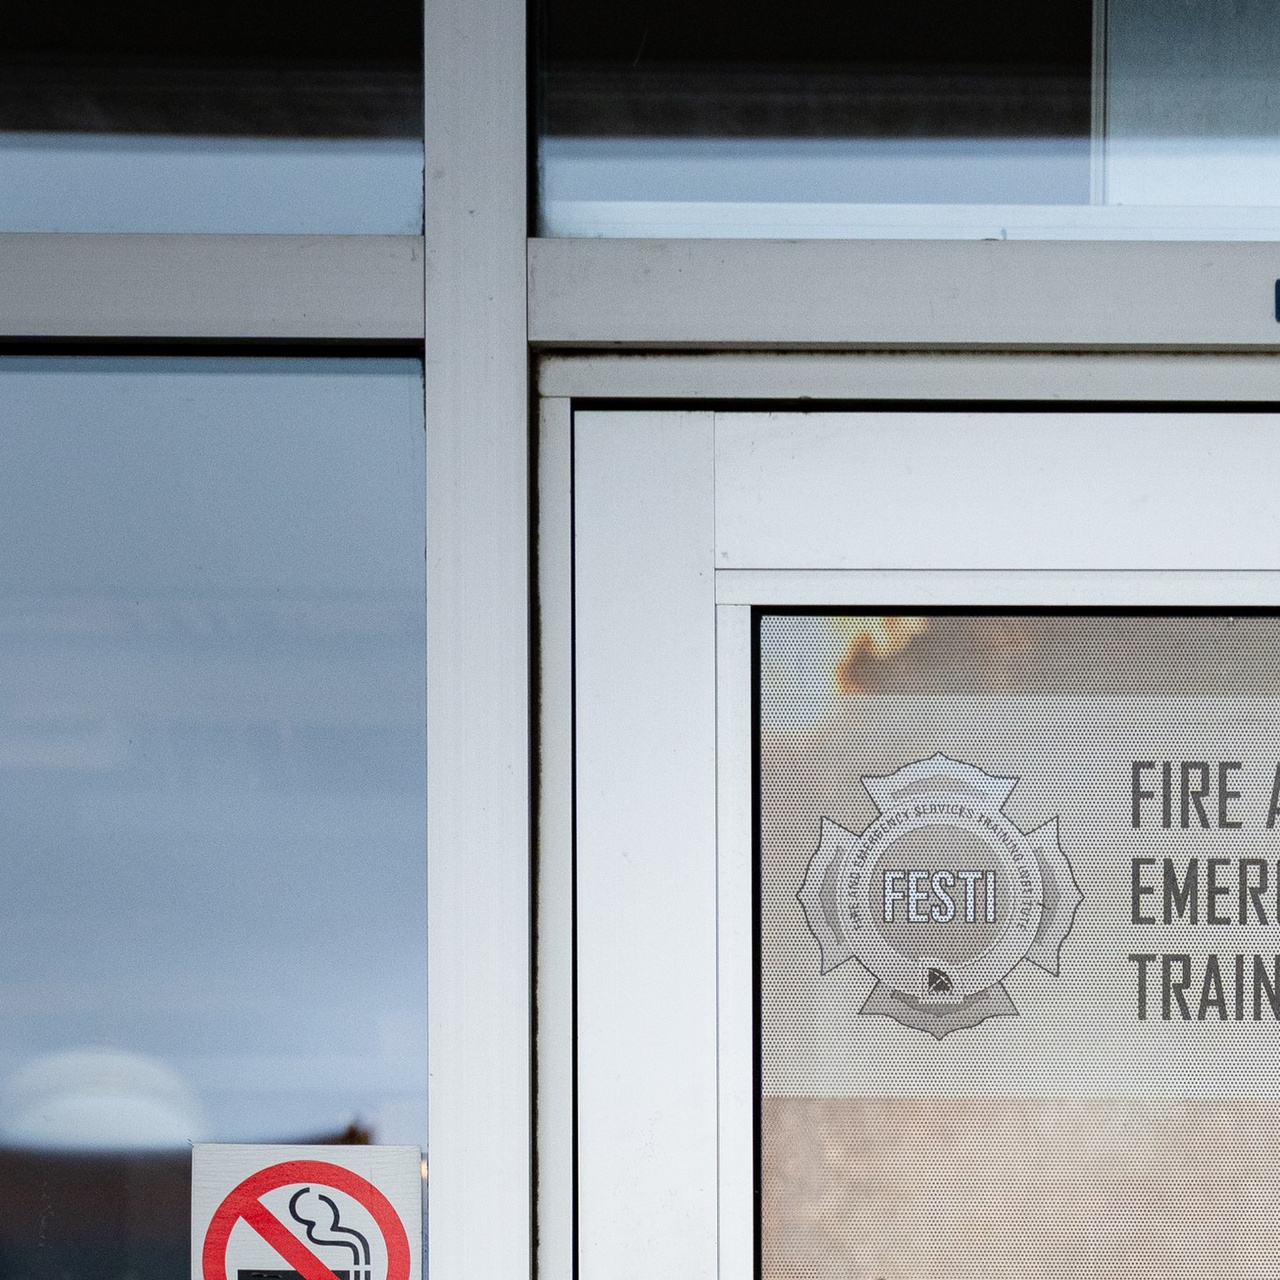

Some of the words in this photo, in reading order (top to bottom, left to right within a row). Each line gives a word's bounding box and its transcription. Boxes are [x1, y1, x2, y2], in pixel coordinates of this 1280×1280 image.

[914, 803, 975, 820] SERVICES
[1131, 761, 1243, 829] FIRE
[882, 869, 997, 924] FESTI
